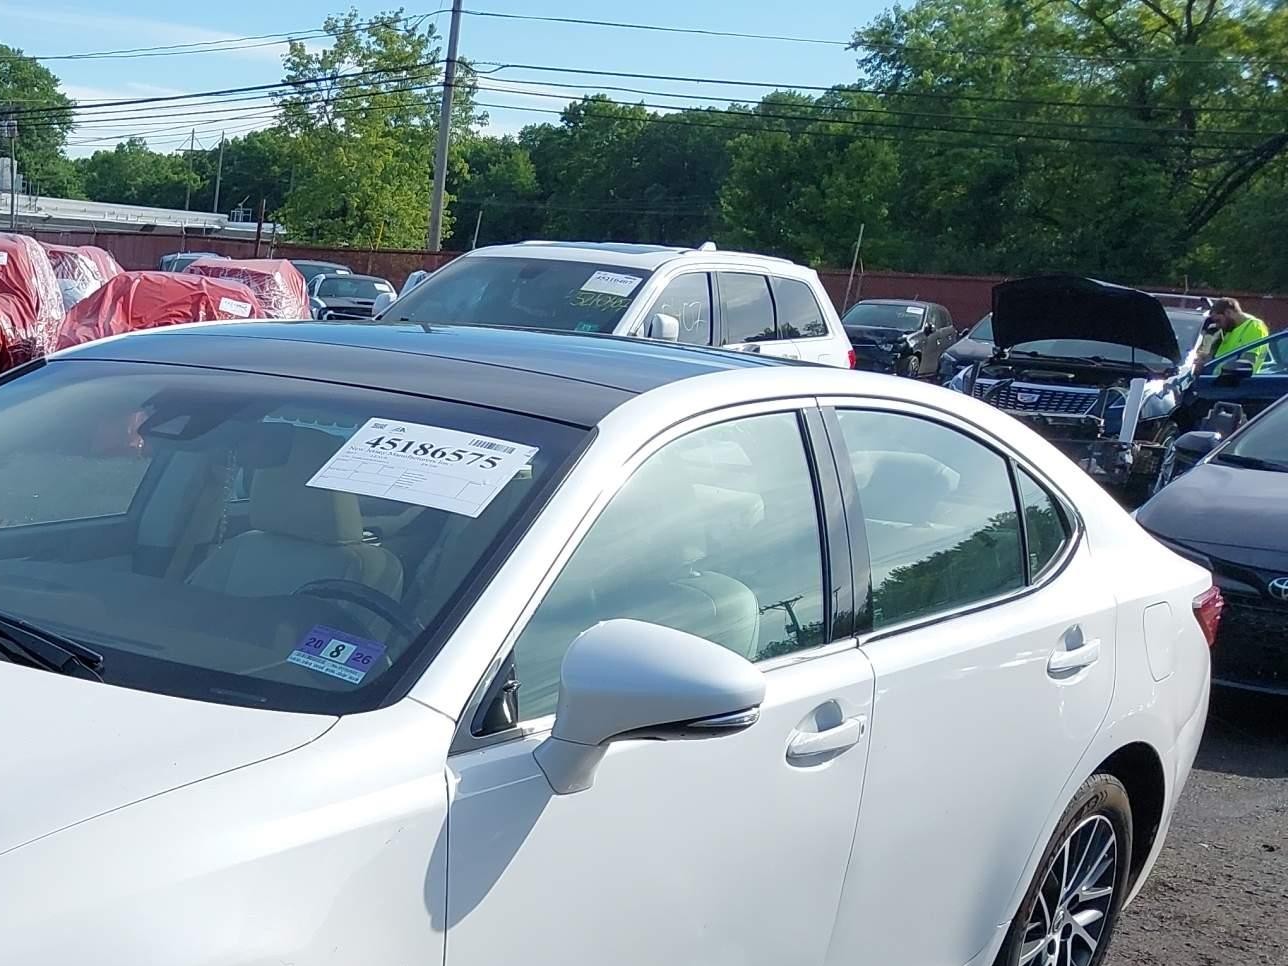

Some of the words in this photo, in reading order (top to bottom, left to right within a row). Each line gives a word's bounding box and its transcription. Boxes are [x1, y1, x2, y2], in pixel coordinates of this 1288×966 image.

[365, 435, 502, 469] 45186575
[329, 643, 346, 658] 8
[353, 653, 371, 665] 26
